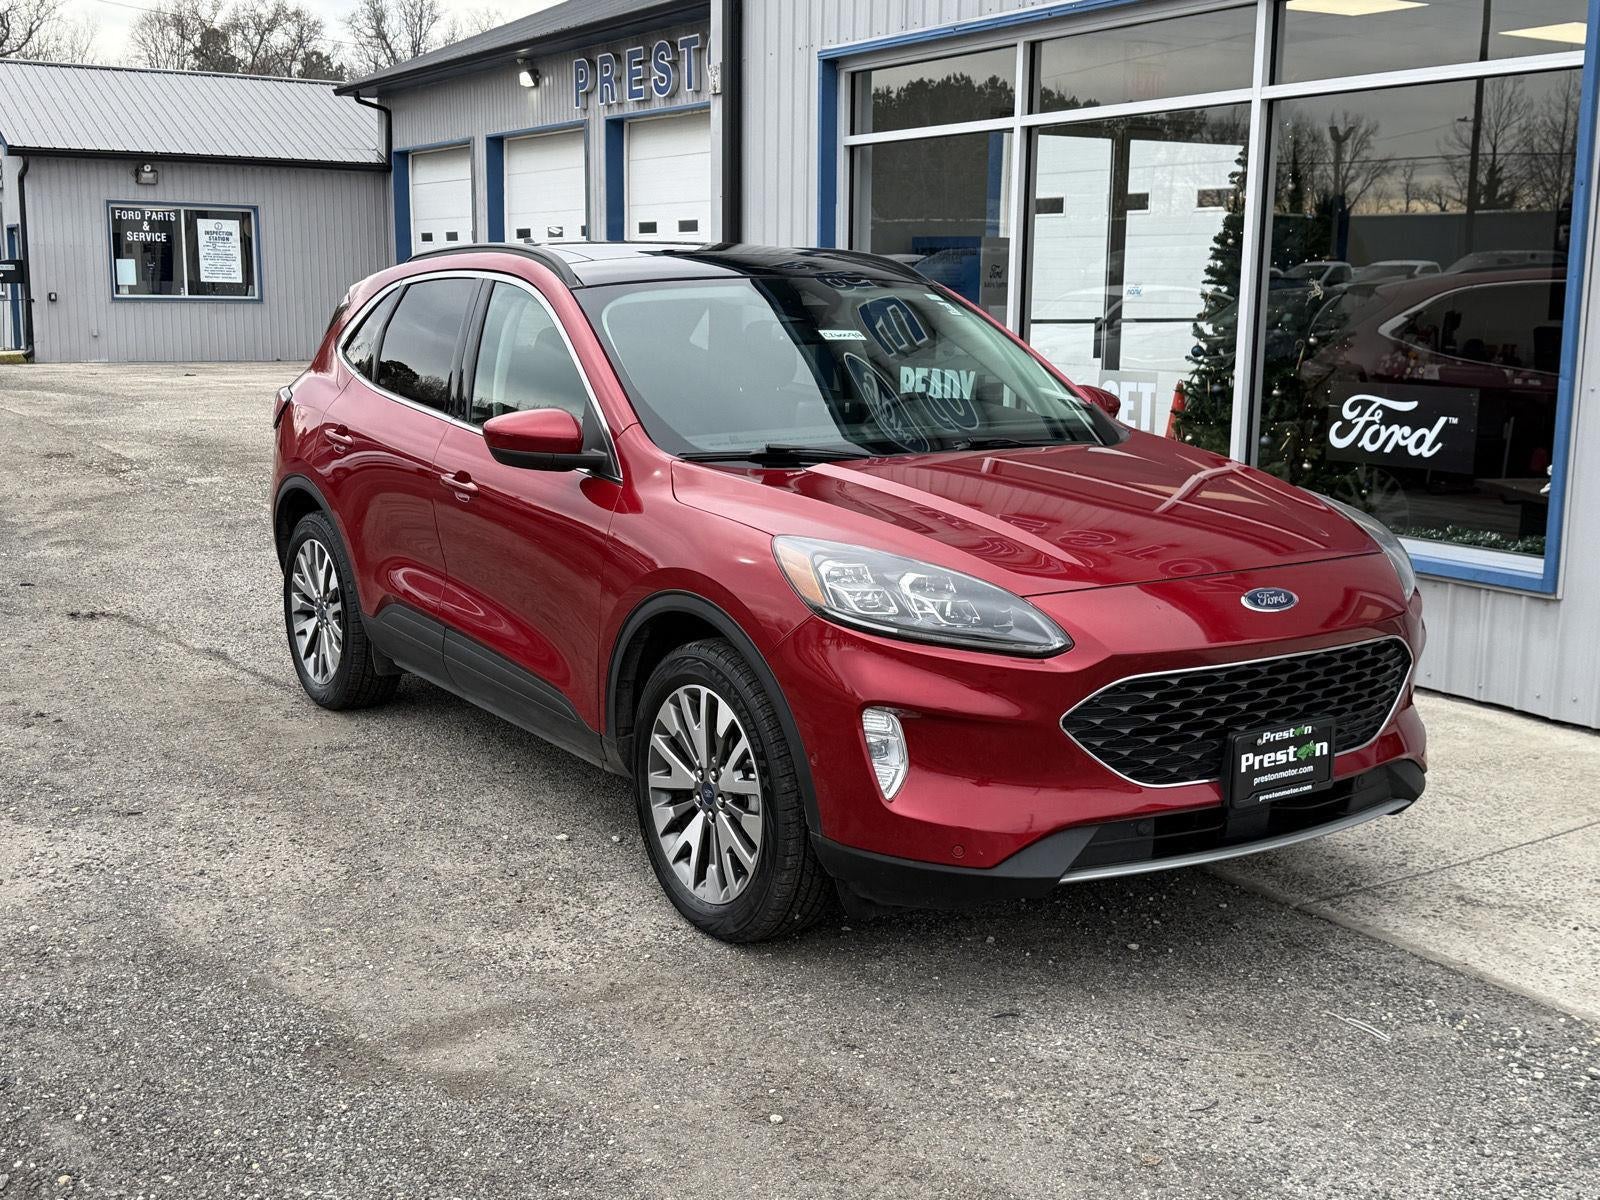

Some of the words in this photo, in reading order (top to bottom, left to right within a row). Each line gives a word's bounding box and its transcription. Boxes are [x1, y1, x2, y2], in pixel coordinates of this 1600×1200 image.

[573, 33, 711, 109] PREST
[115, 210, 141, 220] FORD
[145, 210, 176, 221] PARTS
[142, 221, 150, 231] &
[126, 231, 167, 242] SERVICE
[900, 366, 976, 400] READY
[1329, 394, 1447, 458] Ford
[1256, 591, 1288, 606] Ford
[1253, 765, 1314, 786] prestonmotor.com
[1259, 784, 1313, 802] prestonmotor.com
